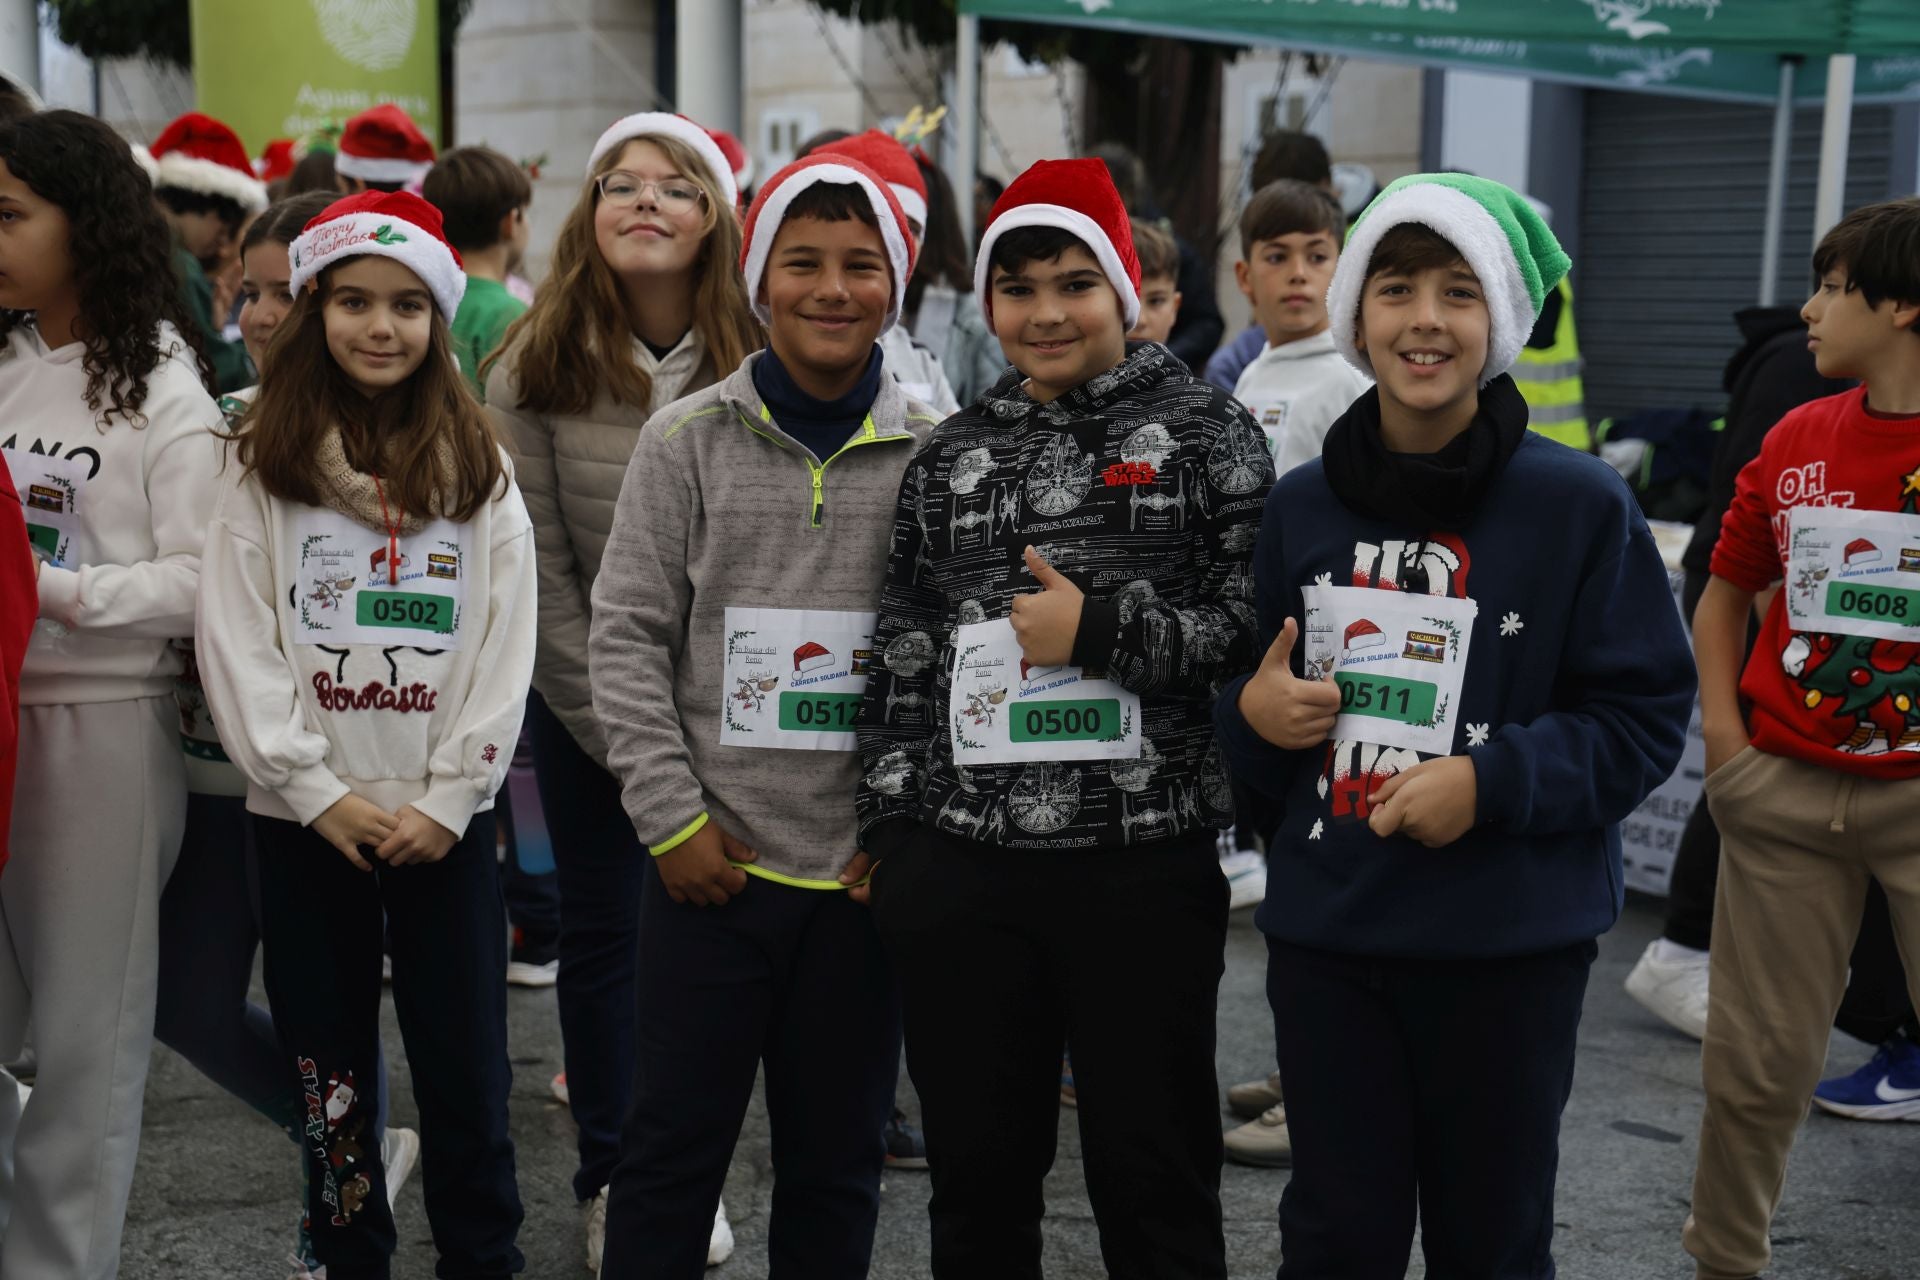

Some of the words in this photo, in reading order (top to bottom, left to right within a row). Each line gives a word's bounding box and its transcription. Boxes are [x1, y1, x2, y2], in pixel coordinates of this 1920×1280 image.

[312, 222, 356, 242] Merry
[1107, 461, 1156, 474] STAR
[1101, 471, 1159, 487] WARS
[1777, 461, 1825, 505] OH
[1022, 521, 1062, 534] STAR
[1062, 514, 1105, 528] WARS
[1093, 570, 1136, 582] STAR
[373, 598, 439, 625] 0502
[1839, 588, 1909, 619] 0608
[744, 645, 764, 654] Busca
[765, 646, 777, 655] del
[745, 655, 763, 664] Reno
[974, 659, 990, 667] Busca
[991, 657, 1004, 665] del
[1339, 656, 1365, 668] CARRERA
[1367, 652, 1399, 663] SOLIDARIA
[790, 676, 819, 688] CARRERA
[820, 670, 849, 682] SOLIDARIA
[1018, 685, 1046, 698] CARRERA
[1047, 676, 1079, 689] SOLIDARIA
[1340, 680, 1411, 715] 0511
[1026, 707, 1101, 736] 0500
[1007, 839, 1051, 849] STAR
[1051, 835, 1097, 849] WARS
[297, 1055, 326, 1142] XMAS
